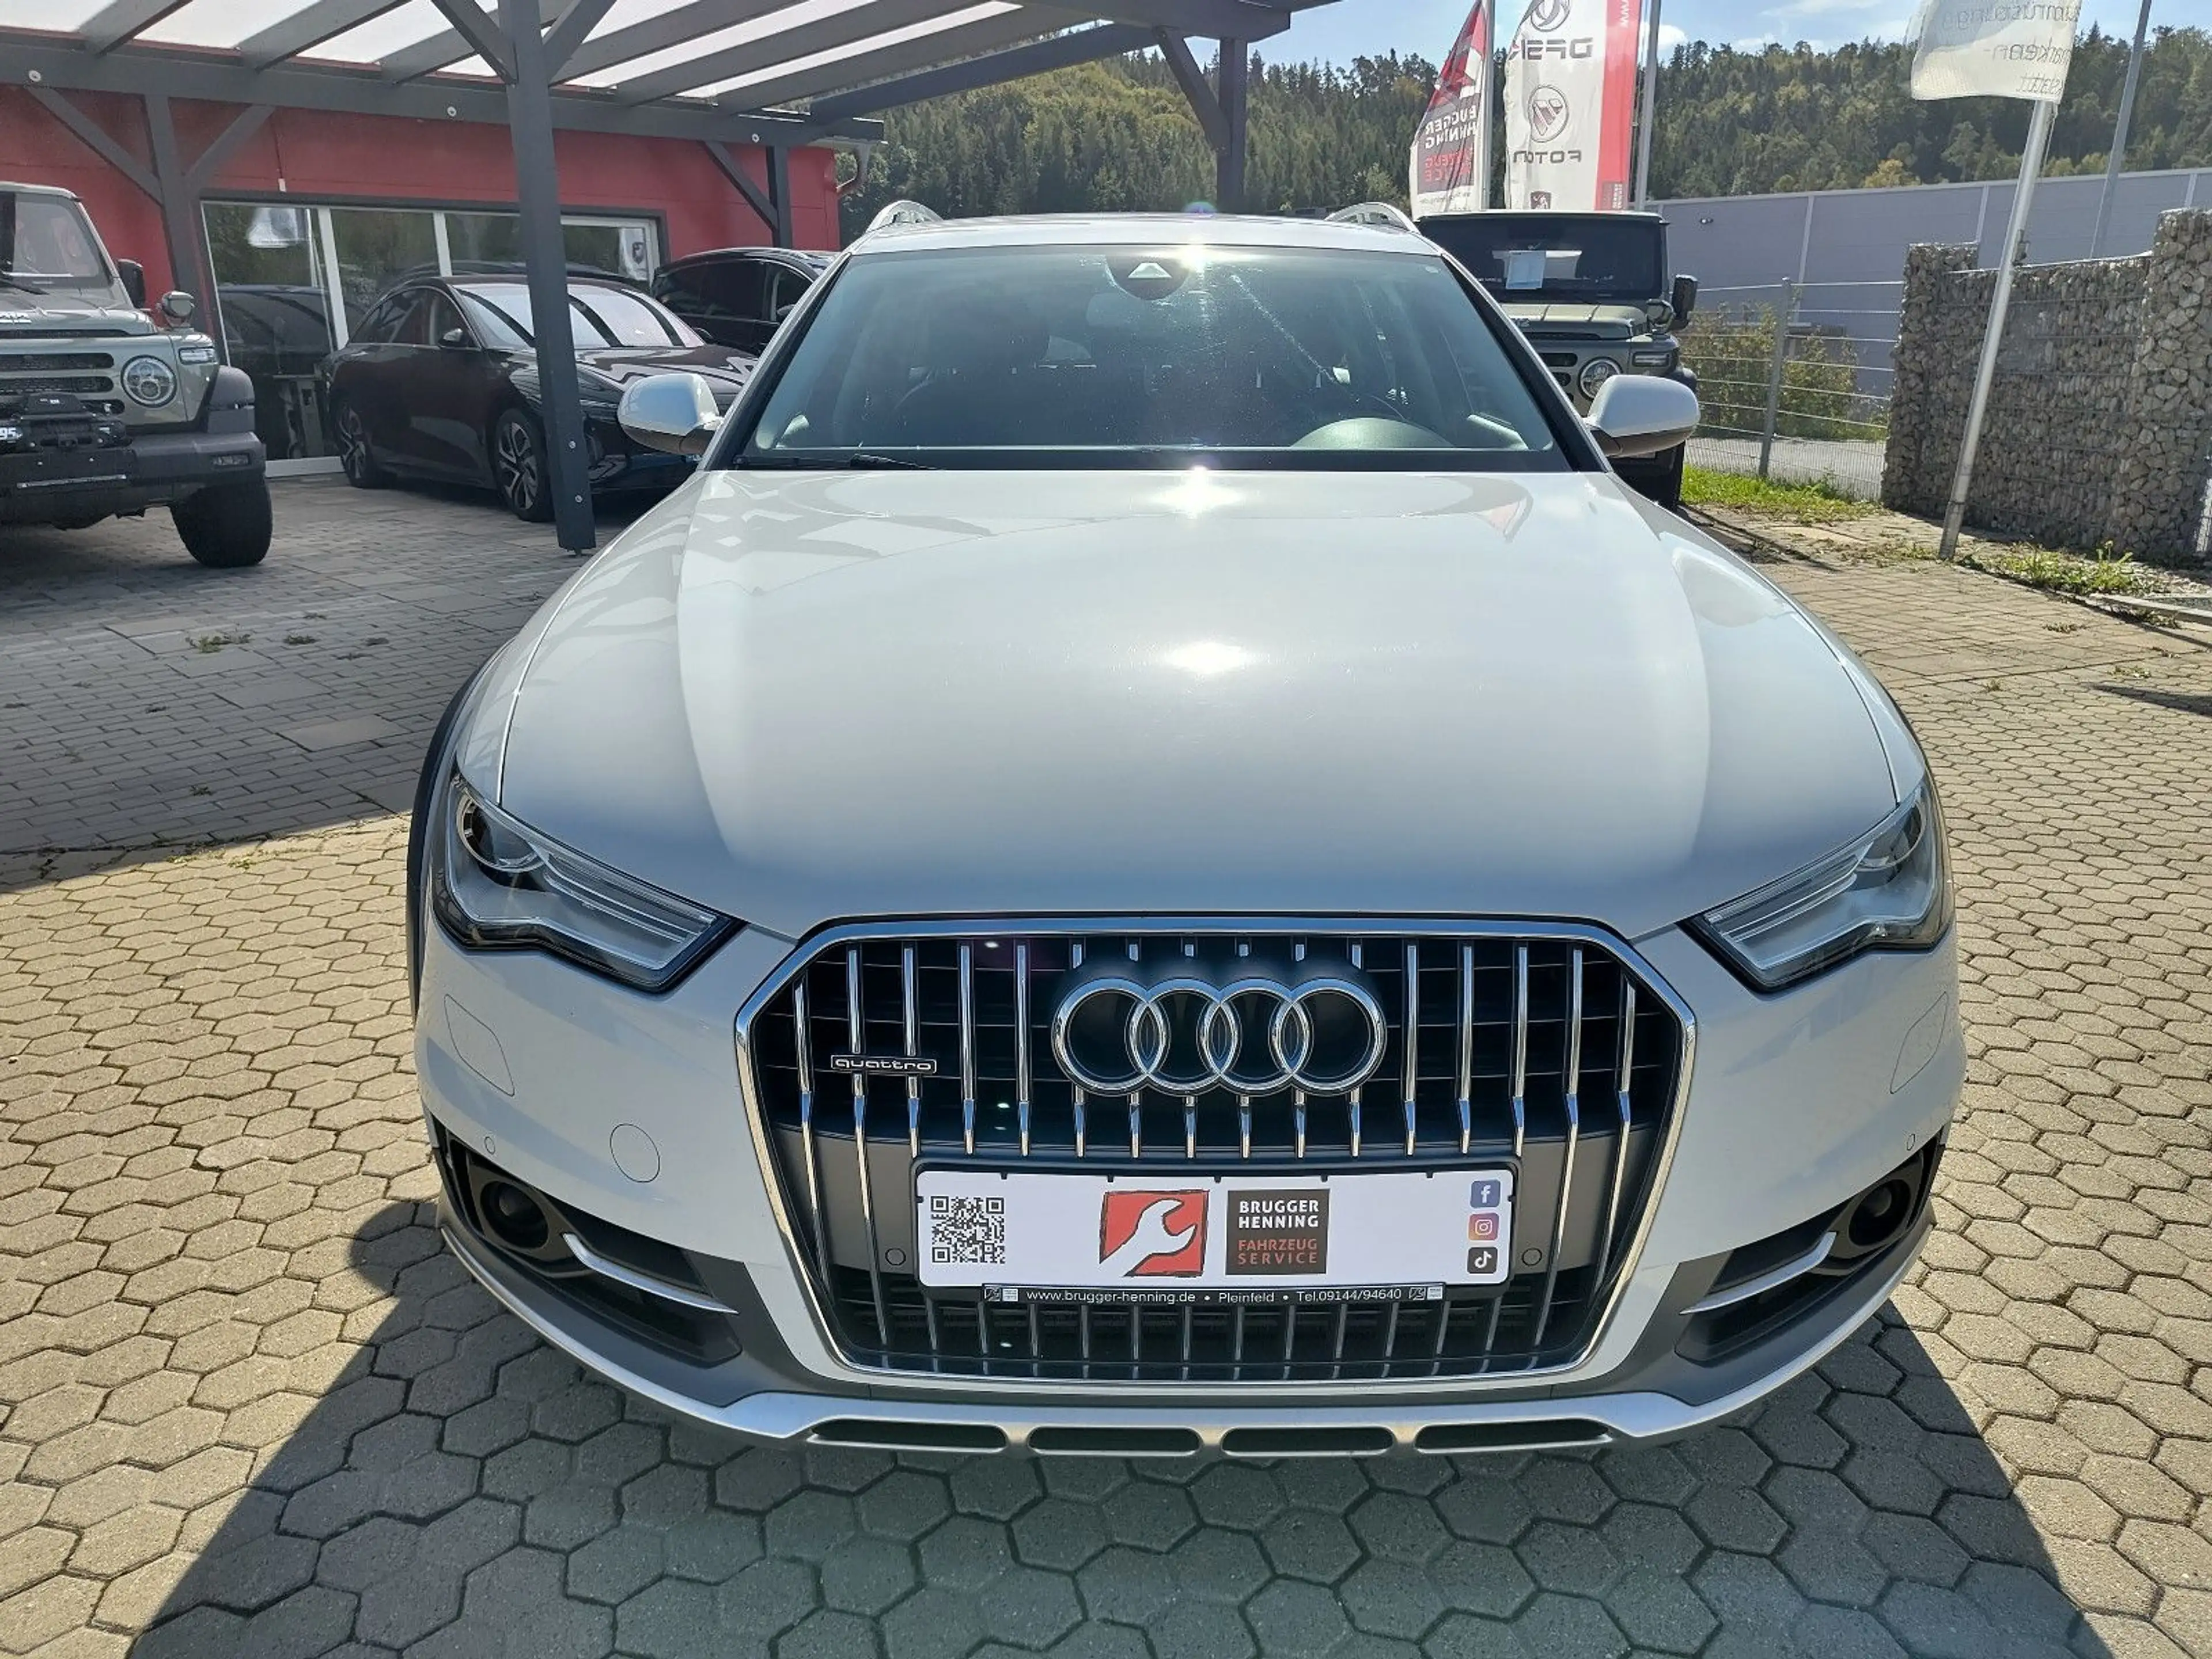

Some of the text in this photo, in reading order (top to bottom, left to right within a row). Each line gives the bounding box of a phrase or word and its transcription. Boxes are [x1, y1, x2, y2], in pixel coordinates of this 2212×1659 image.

[835, 1059, 931, 1070] quattro
[1239, 1200, 1319, 1213] BRUGGER
[1238, 1215, 1319, 1229] HENNING
[1238, 1238, 1317, 1251] FAHRZEUG
[1238, 1252, 1317, 1264] SERVICE
[1026, 1290, 1196, 1305] www.brugger-henning.de
[1219, 1291, 1275, 1303] Pleinfeld
[1297, 1289, 1402, 1302] Tel.09144/94640
